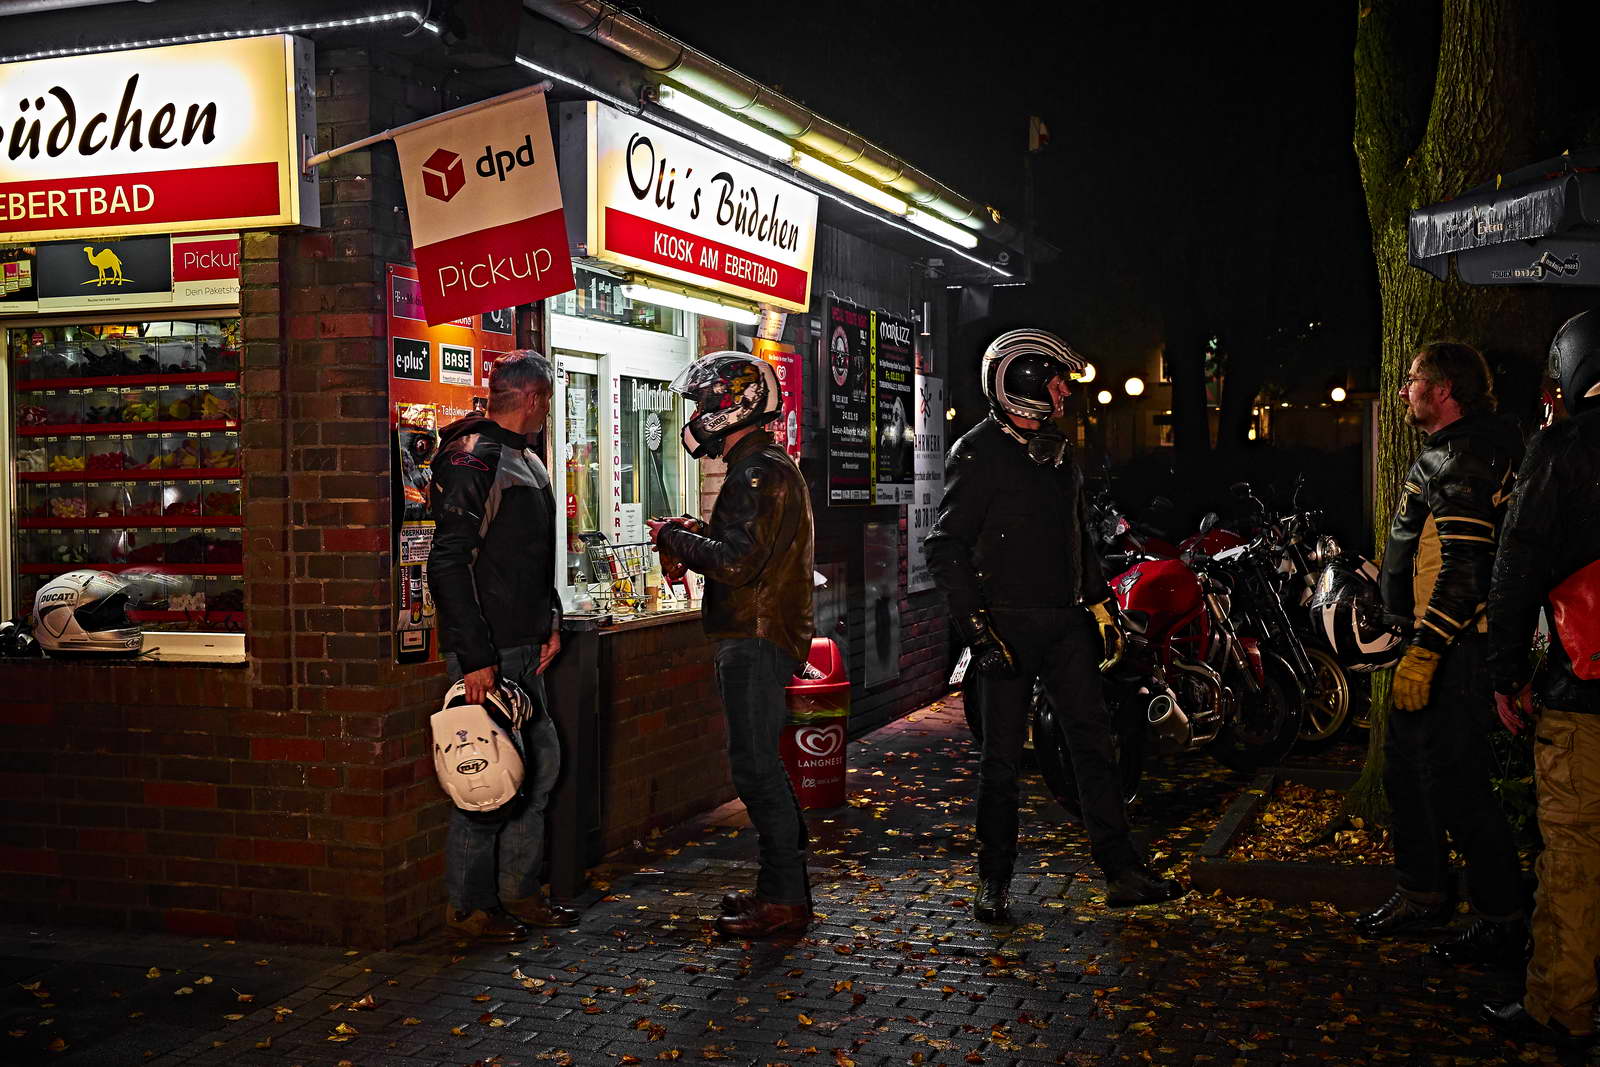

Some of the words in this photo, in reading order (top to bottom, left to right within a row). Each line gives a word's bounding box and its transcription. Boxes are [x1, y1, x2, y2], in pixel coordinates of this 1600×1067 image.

[0, 73, 217, 160] üdchen
[475, 134, 535, 182] dpd
[711, 172, 799, 252] Büdchen
[438, 248, 552, 297] Pickup
[653, 231, 694, 264] KIOSK
[699, 247, 719, 270] AM
[724, 253, 778, 287] EBERTBAD
[185, 288, 203, 297] Dein
[444, 352, 470, 368] BASE
[708, 414, 727, 428] SHOEI
[41, 592, 75, 603] DUCATI
